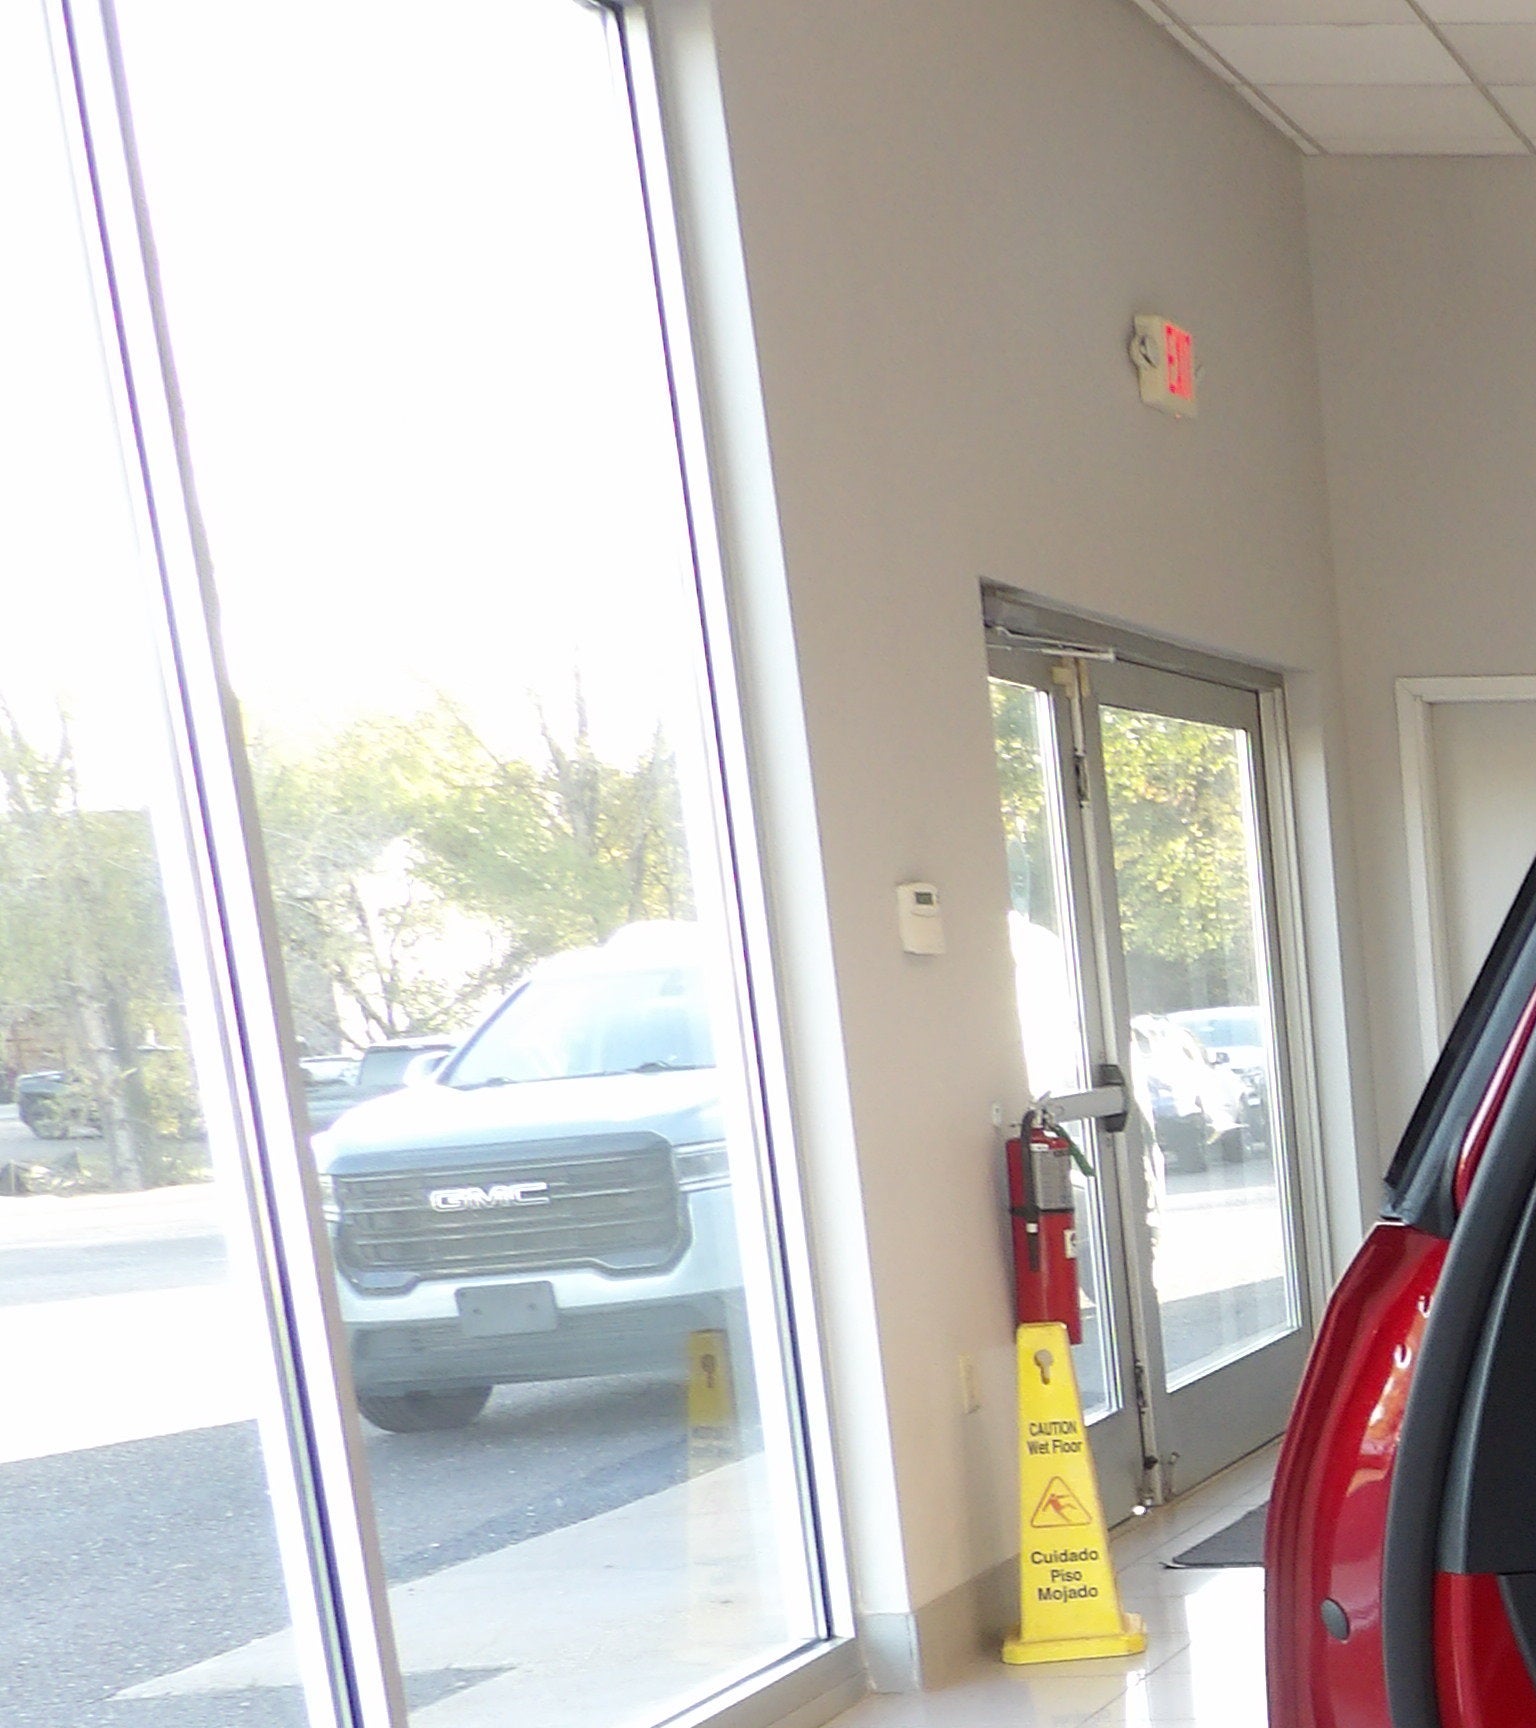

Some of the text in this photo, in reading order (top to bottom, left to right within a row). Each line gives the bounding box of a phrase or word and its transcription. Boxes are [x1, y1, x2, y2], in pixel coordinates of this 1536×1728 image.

[429, 1181, 551, 1213] GMC
[1028, 1420, 1078, 1437] CAUTION
[1026, 1439, 1083, 1456] Wet Floor
[1030, 1547, 1100, 1565] Cuidado
[1050, 1568, 1083, 1583] Piso
[1037, 1584, 1099, 1604] Mojado
